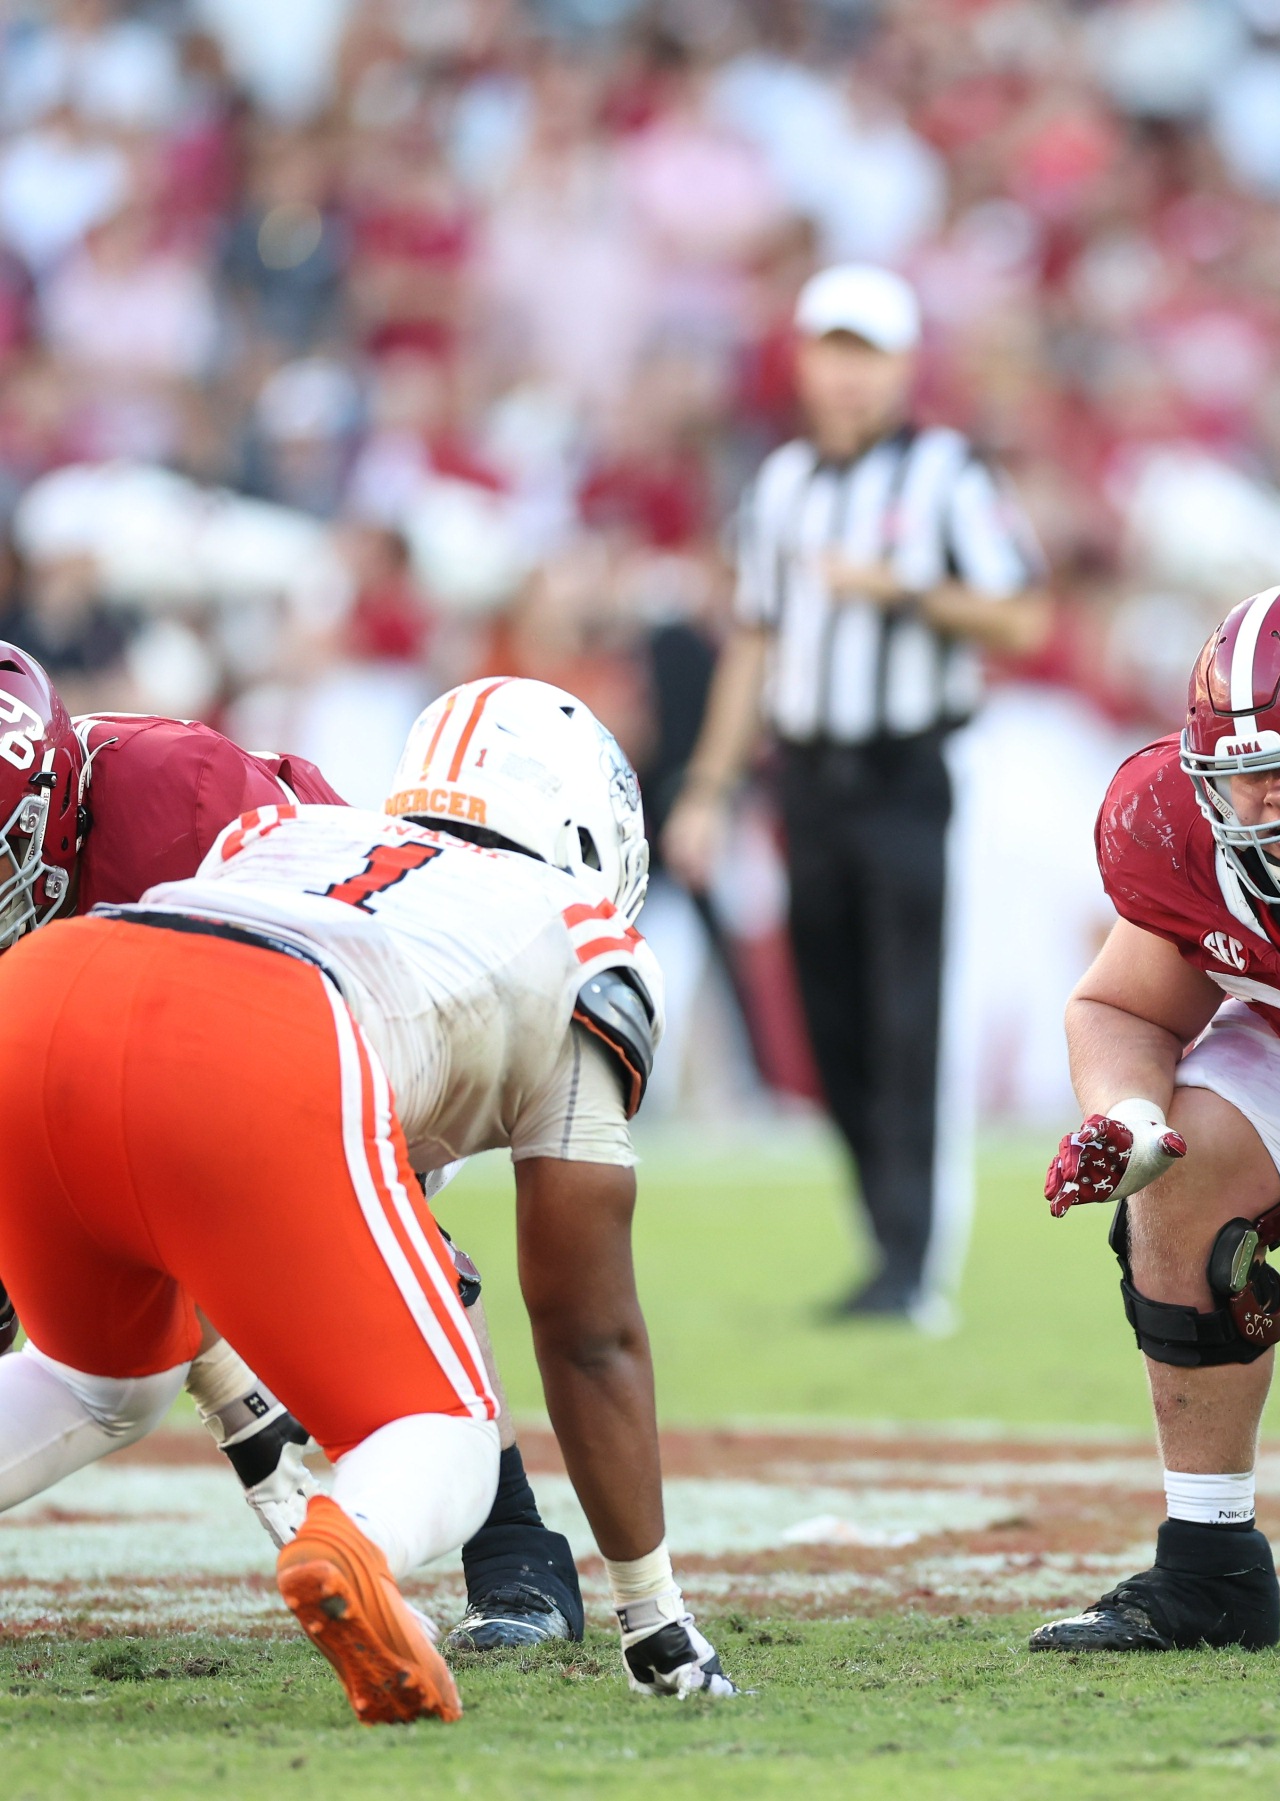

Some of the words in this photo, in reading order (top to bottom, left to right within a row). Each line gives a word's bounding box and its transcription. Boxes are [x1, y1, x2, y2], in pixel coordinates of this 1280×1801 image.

[475, 748, 487, 767] 1
[1226, 741, 1262, 755] BAMA
[384, 788, 487, 824] MERCER
[1214, 798, 1234, 820] TIDE
[1203, 930, 1246, 971] SEC
[1218, 1510, 1249, 1519] NIKE
